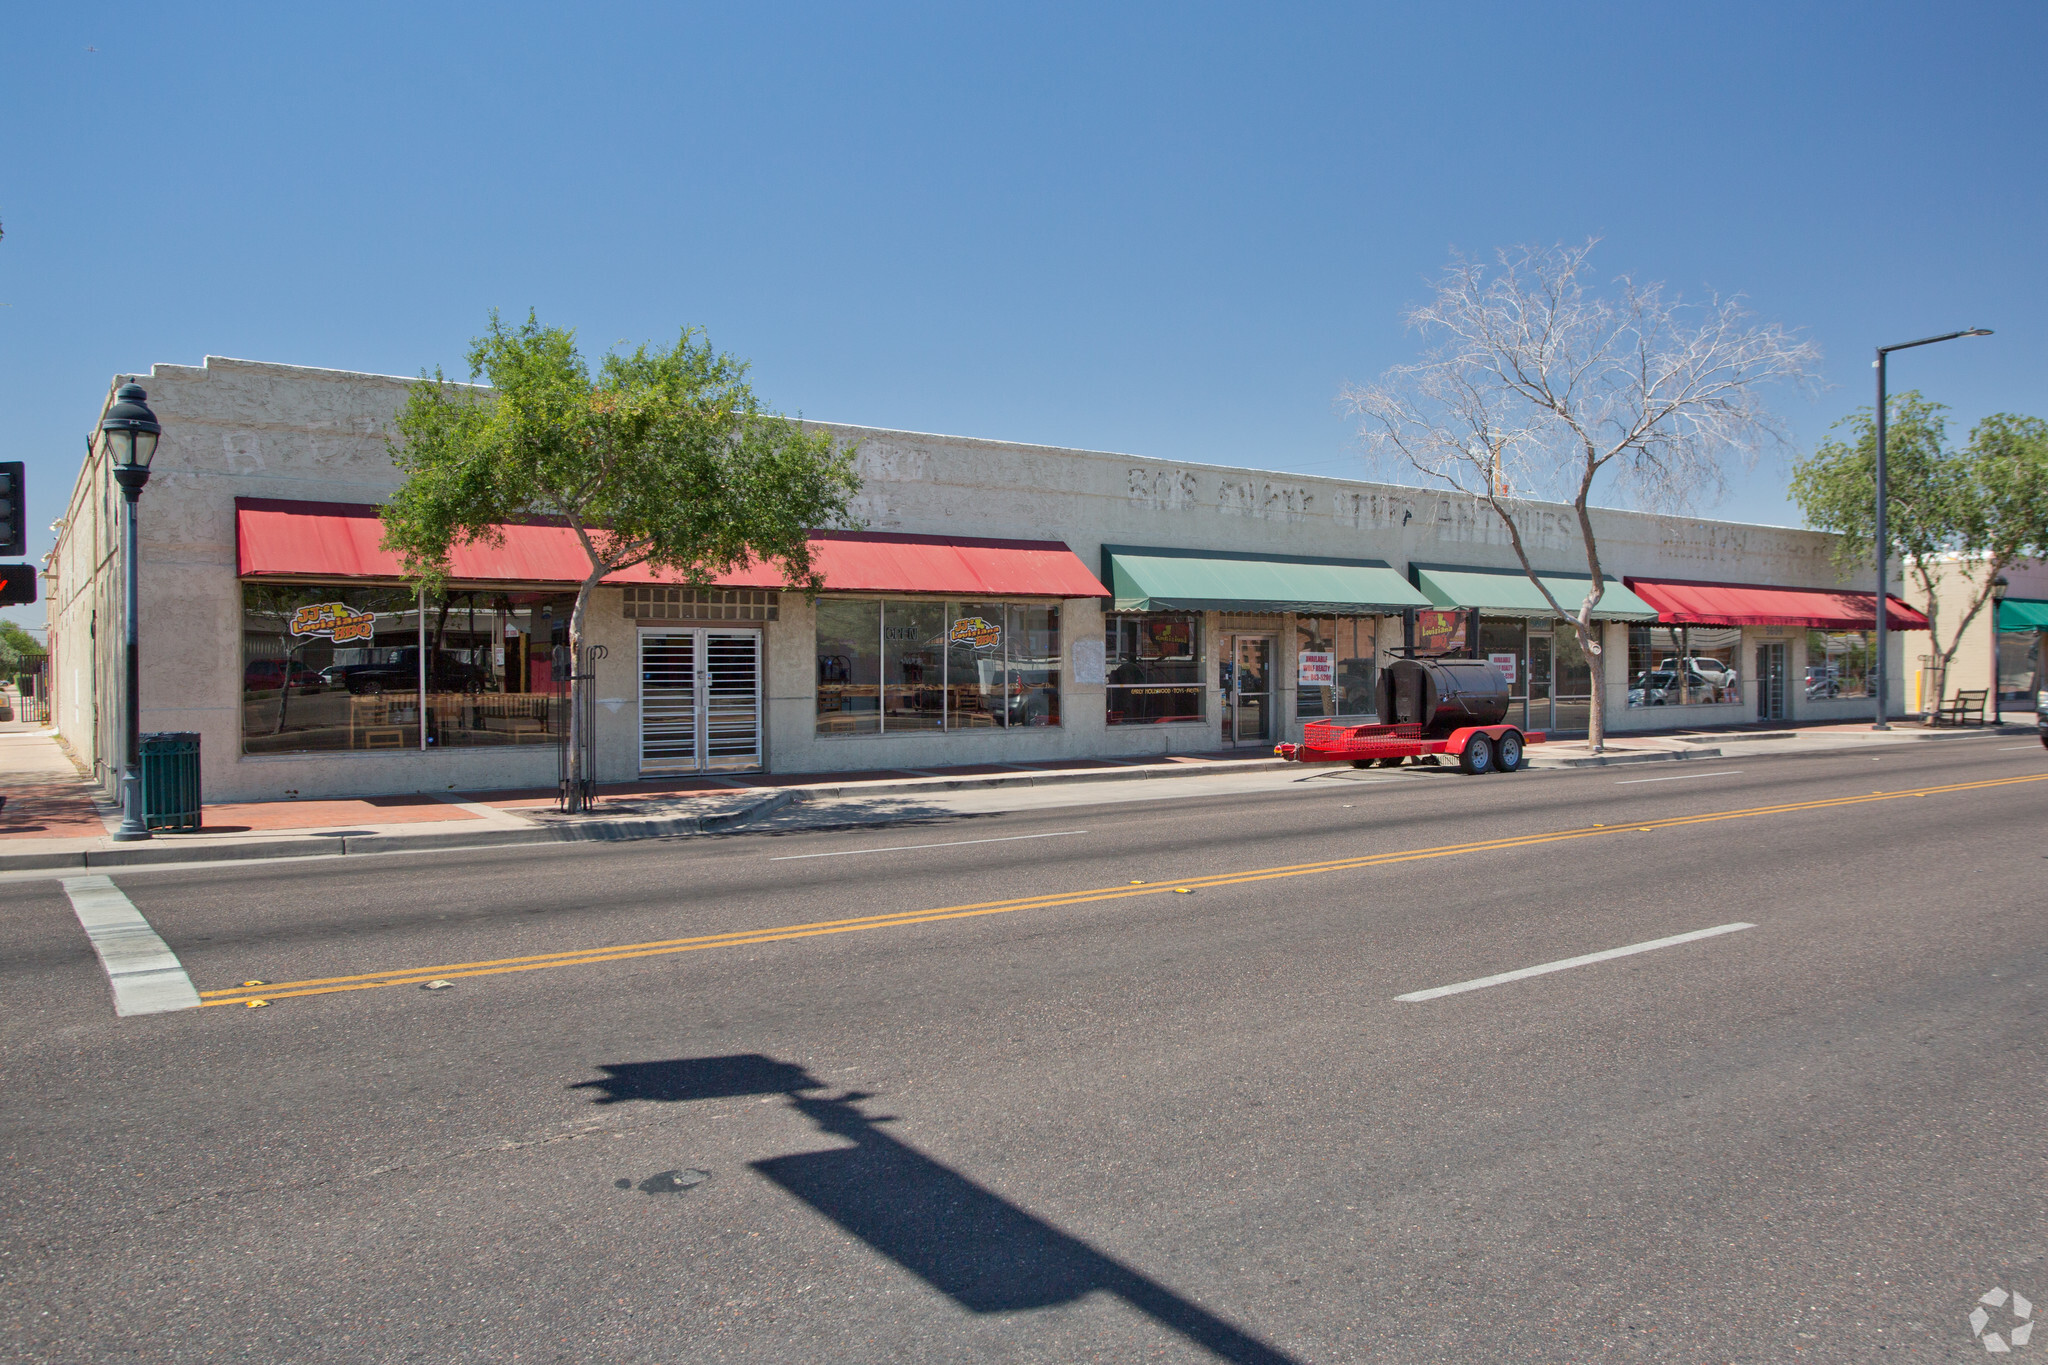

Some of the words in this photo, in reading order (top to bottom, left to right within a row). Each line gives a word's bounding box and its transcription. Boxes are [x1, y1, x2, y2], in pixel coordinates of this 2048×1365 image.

[292, 613, 374, 634] Louisiana
[333, 622, 371, 641] BBQ
[886, 627, 918, 641] OPEN
[951, 626, 1000, 640] Louisiana
[975, 634, 999, 648] BBQ
